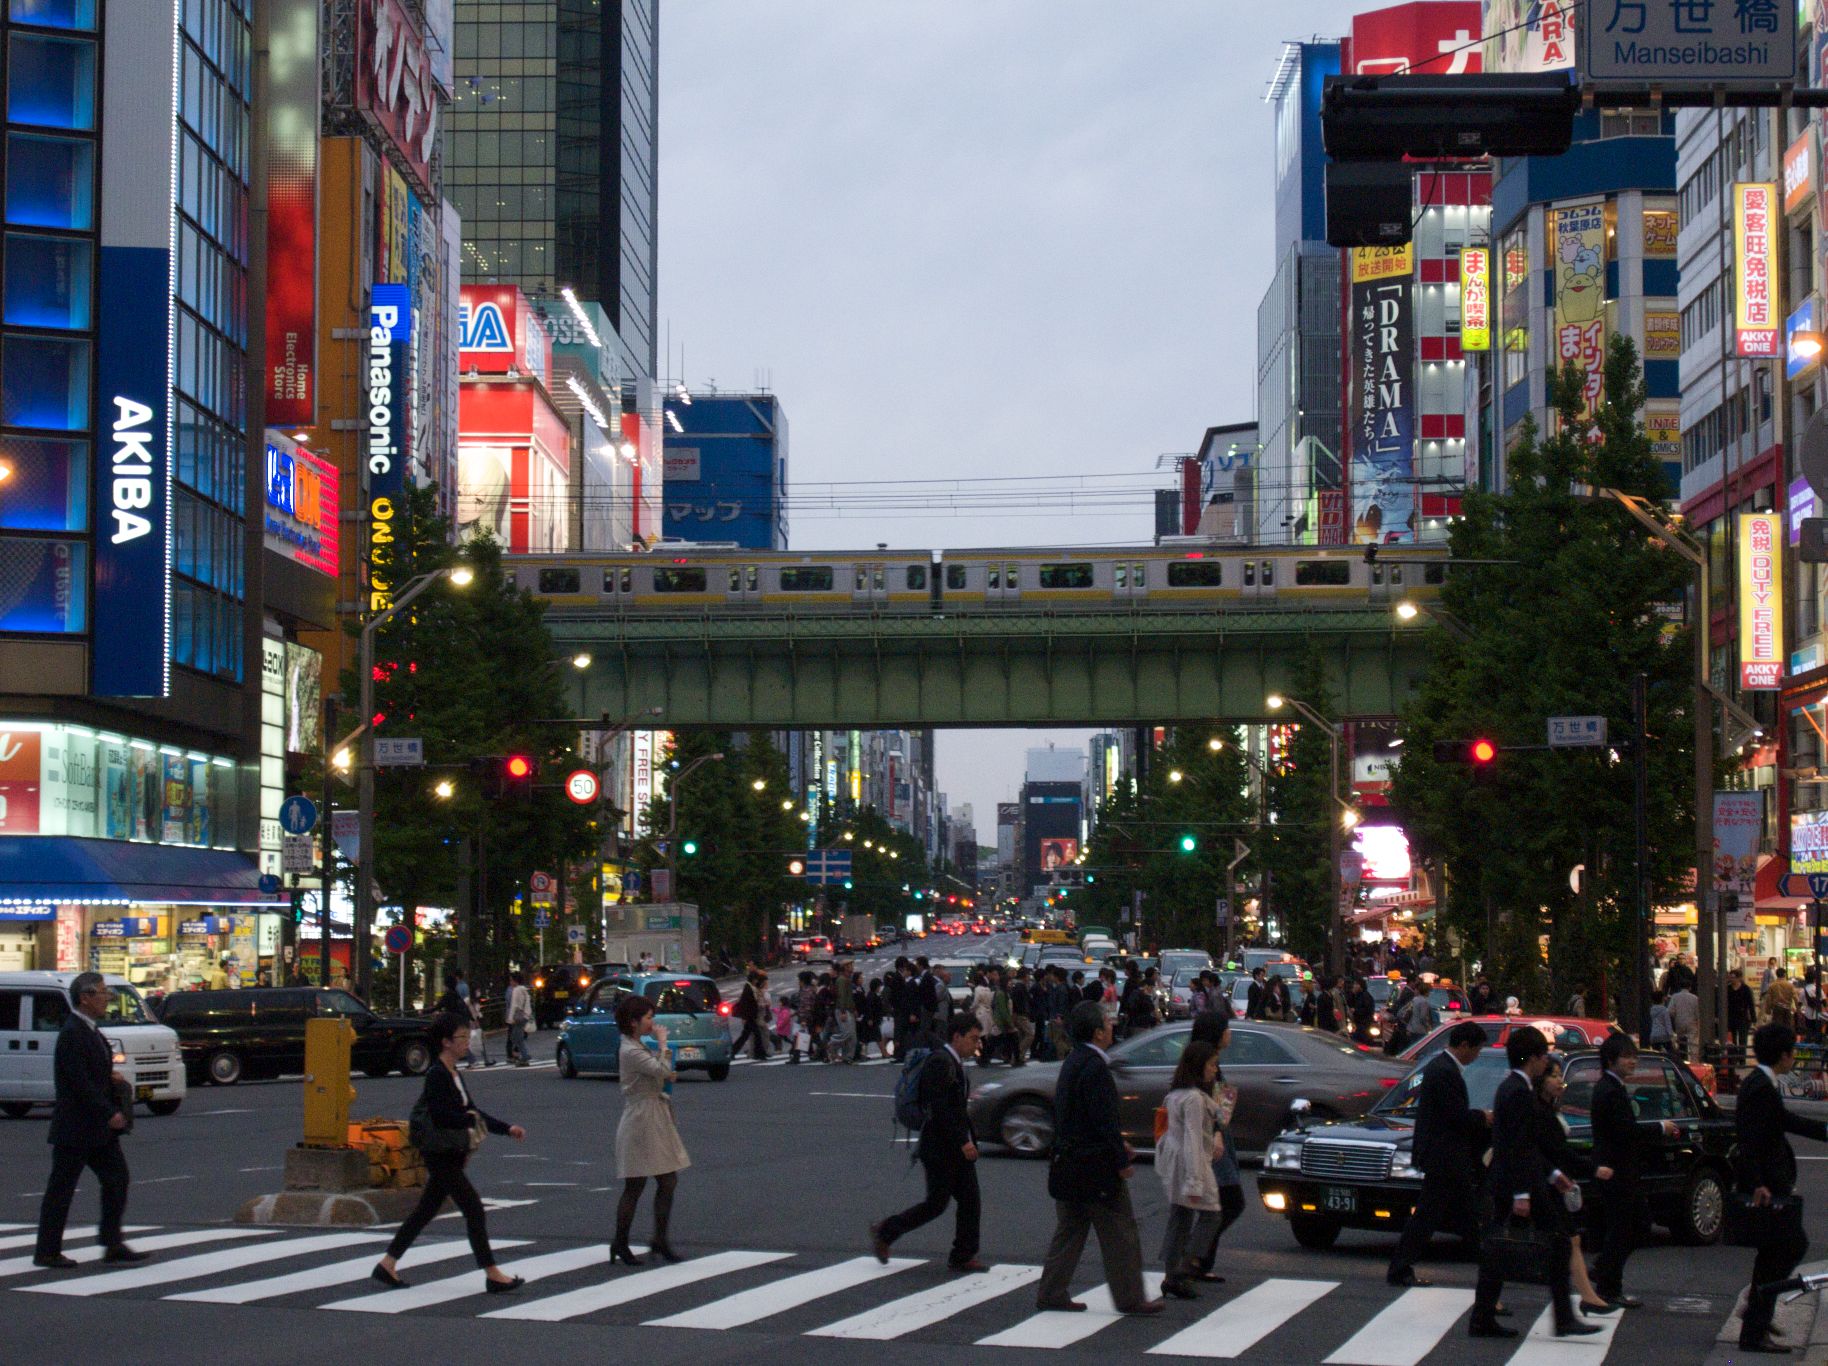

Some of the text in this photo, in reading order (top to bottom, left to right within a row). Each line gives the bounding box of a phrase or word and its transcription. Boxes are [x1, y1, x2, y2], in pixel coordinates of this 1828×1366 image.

[1615, 41, 1768, 65] Manseibashi
[1558, 217, 1602, 235] 秋葉原店
[1645, 214, 1677, 228] ネット
[1645, 229, 1677, 245] ゲーム
[1744, 189, 1768, 323] 愛客旺免税店
[1358, 257, 1407, 277] 放送開始
[1466, 252, 1485, 327] まんが喫茶
[1741, 332, 1774, 342] AKKY
[1744, 342, 1771, 353] ONE
[286, 332, 297, 400] Electronics
[274, 366, 285, 400] Store
[297, 364, 308, 400] Home
[369, 305, 398, 475] Panasonic
[1659, 430, 1668, 441] &
[112, 396, 152, 544] AKIBA
[668, 501, 743, 521] マップ
[1752, 519, 1772, 658] 免税 DUTY FREE
[1746, 664, 1779, 675] AKKY
[1748, 675, 1776, 685] ONE
[638, 733, 648, 742] Y
[638, 748, 648, 787] FREE
[573, 779, 593, 794] 50
[1813, 876, 1828, 892] 17
[1219, 901, 1228, 912] P
